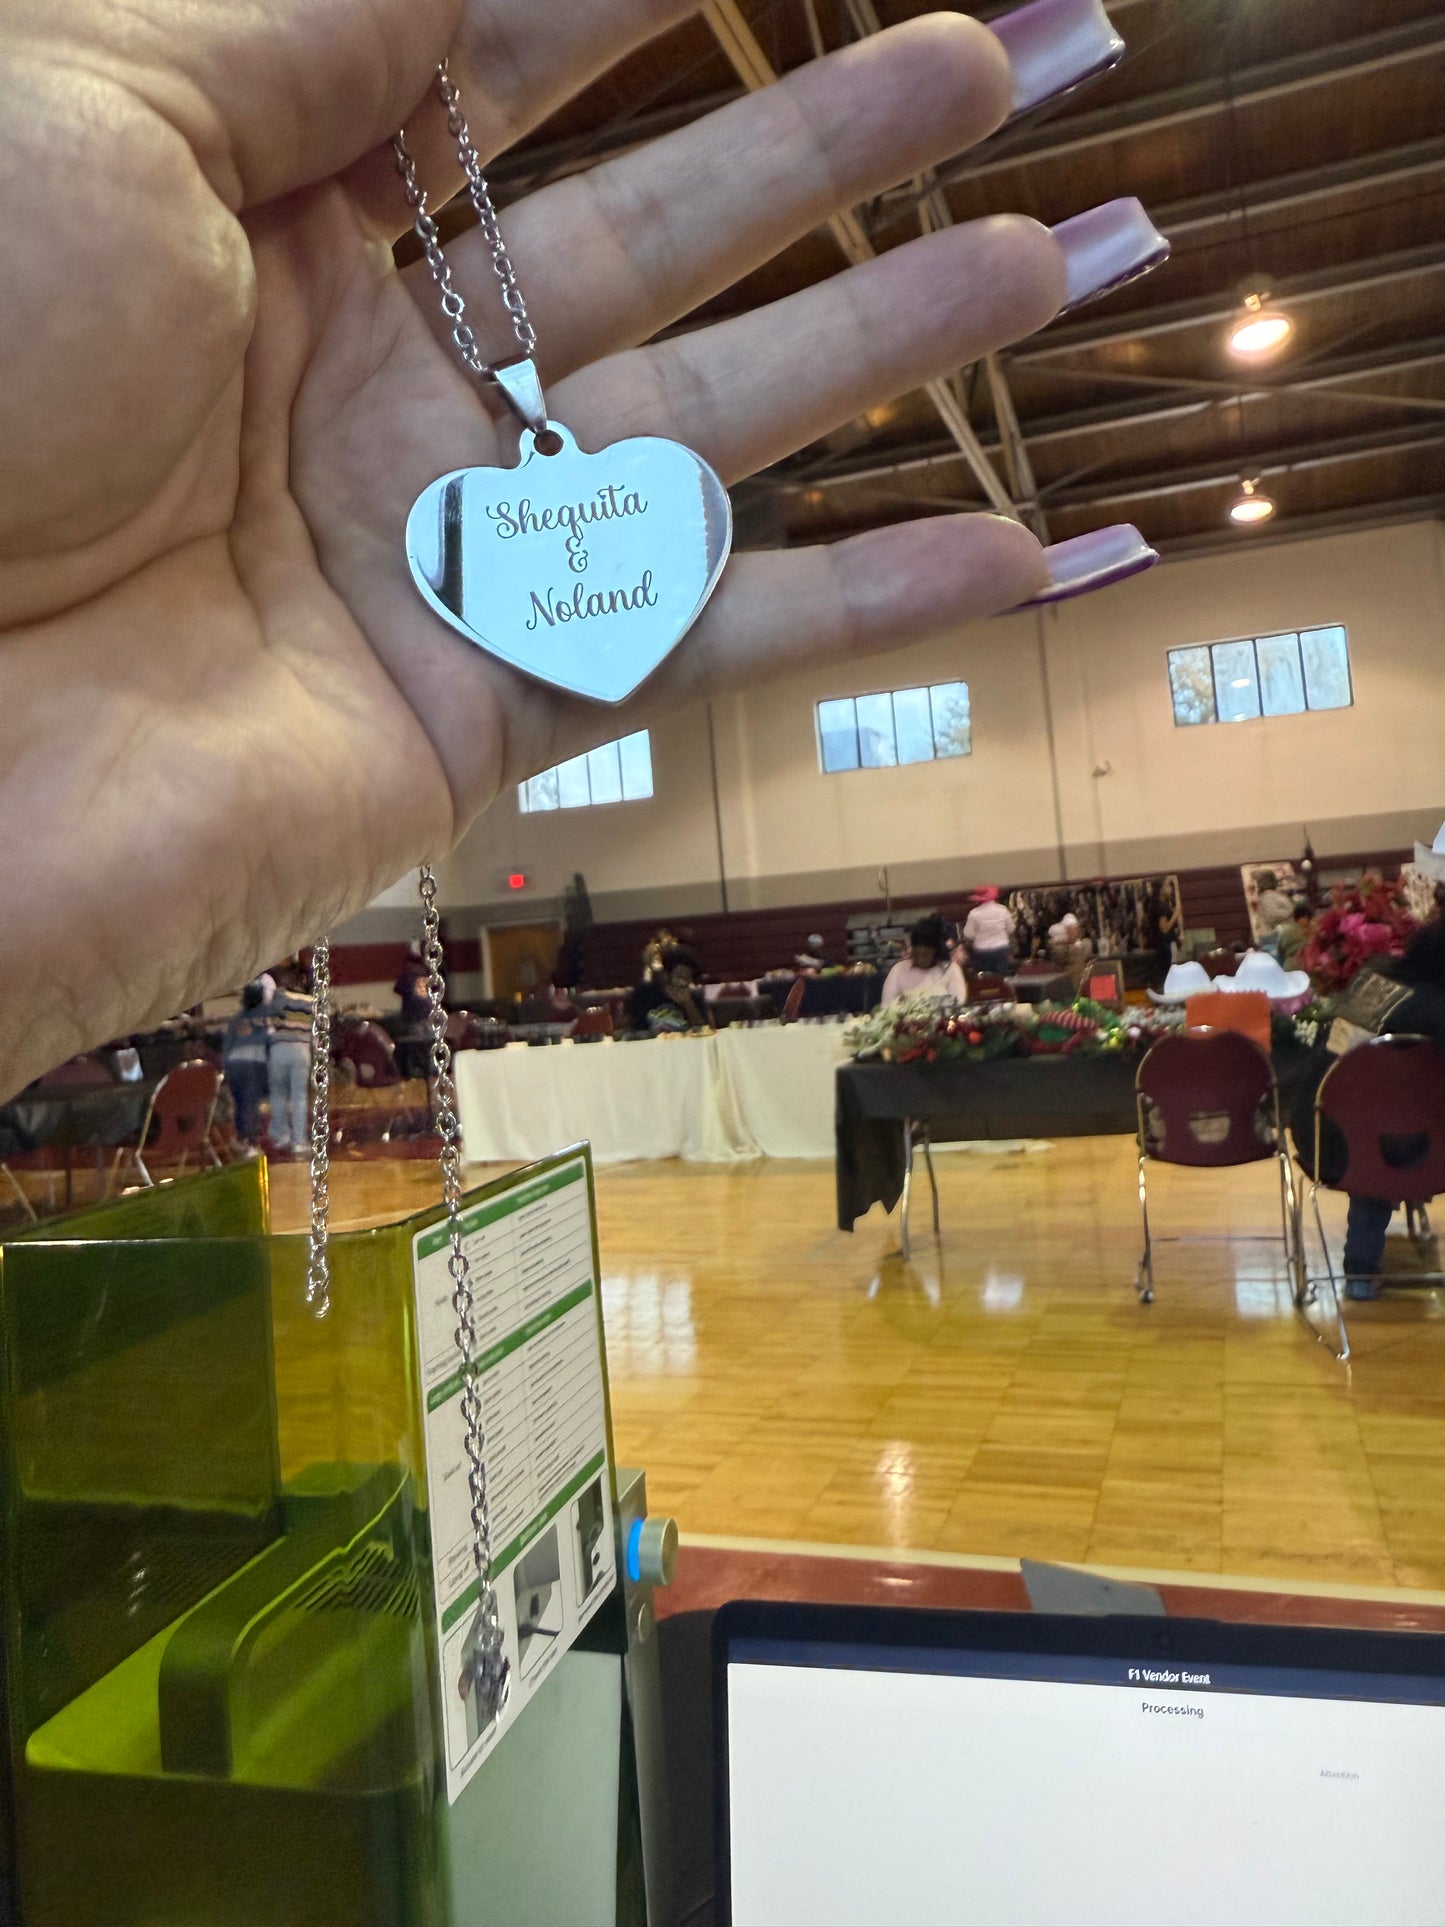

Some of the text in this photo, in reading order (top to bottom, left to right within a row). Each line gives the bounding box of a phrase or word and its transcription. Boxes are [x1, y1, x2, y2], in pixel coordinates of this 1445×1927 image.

[486, 485, 648, 540] Shequita
[565, 536, 588, 573] &
[526, 569, 658, 630] Noland
[1128, 1668, 1211, 1685] F1 Vendor Event
[1142, 1702, 1204, 1719] Processing
